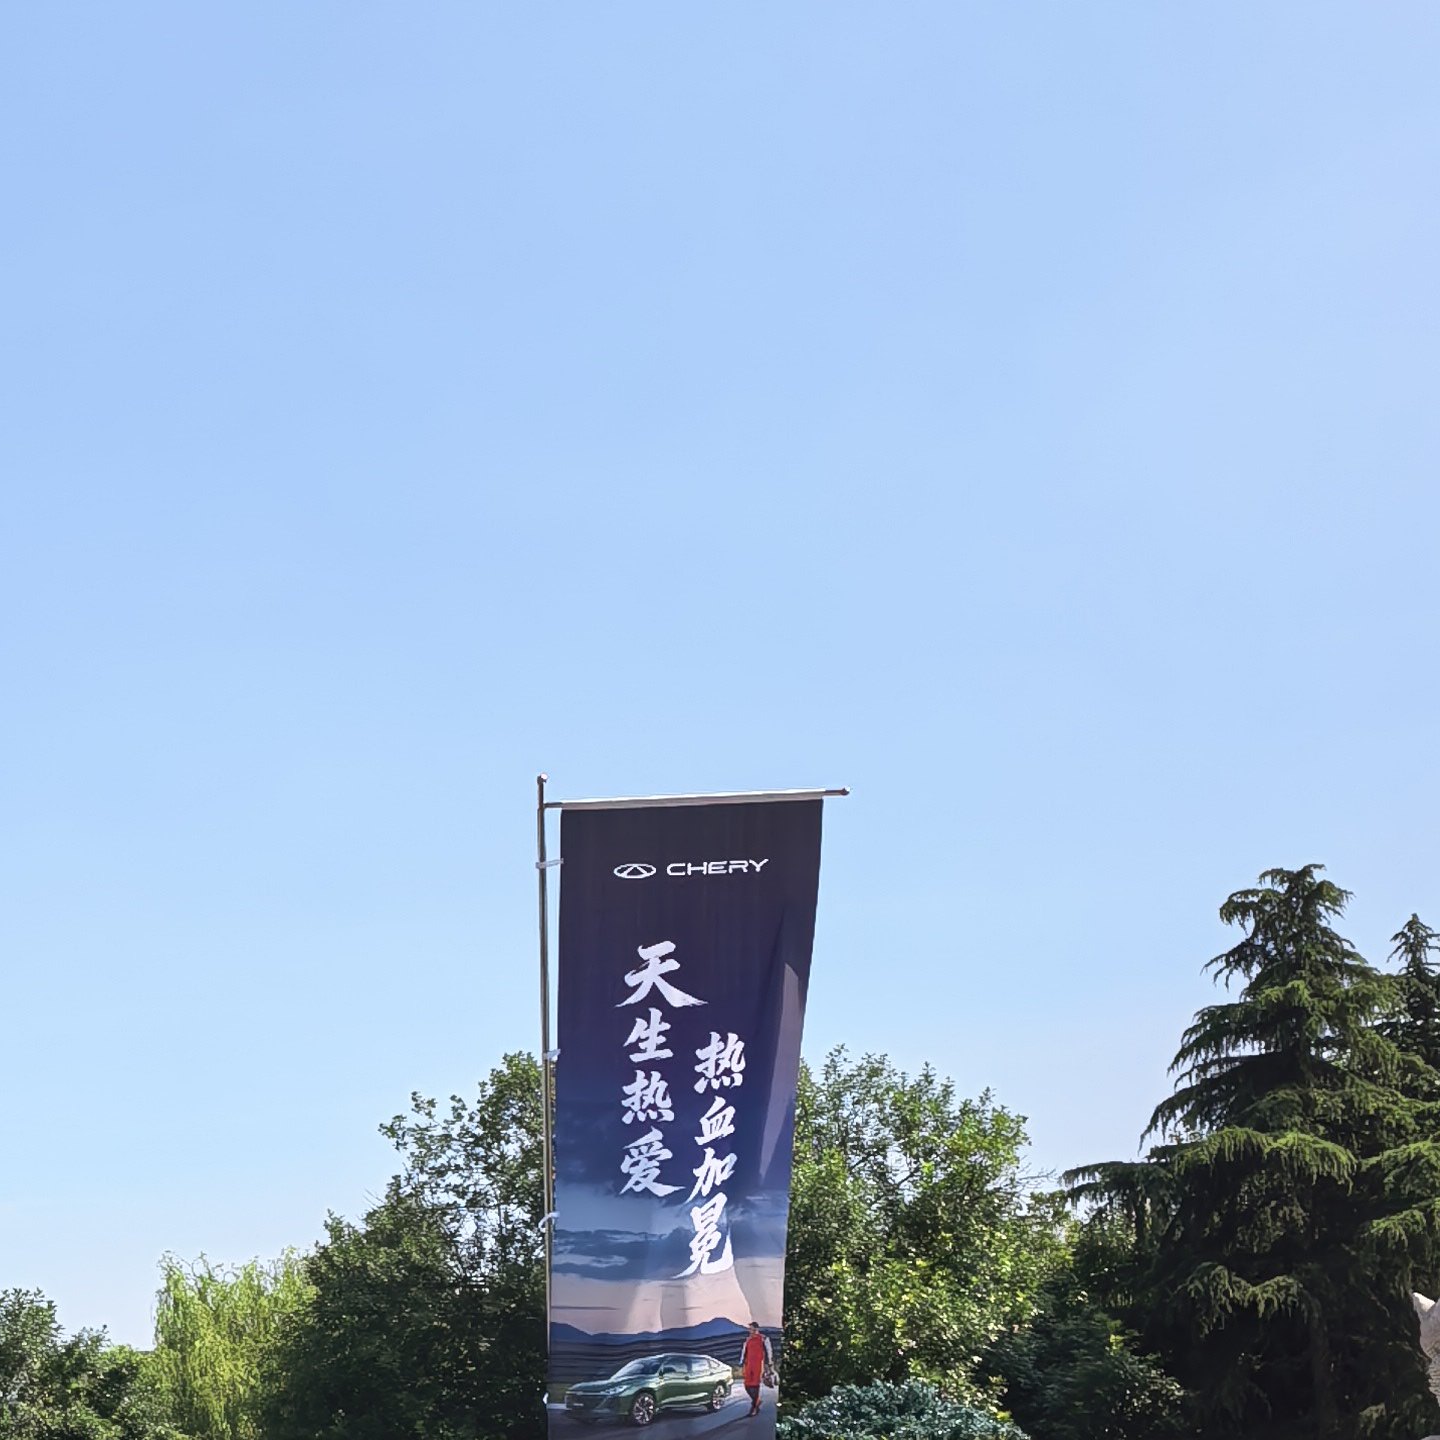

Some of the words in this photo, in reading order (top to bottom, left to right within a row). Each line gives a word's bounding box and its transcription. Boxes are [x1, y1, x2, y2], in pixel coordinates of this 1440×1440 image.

[666, 858, 769, 876] CHERY
[615, 941, 708, 1197] 天生热爱
[676, 1032, 745, 1278] 热血加冕
